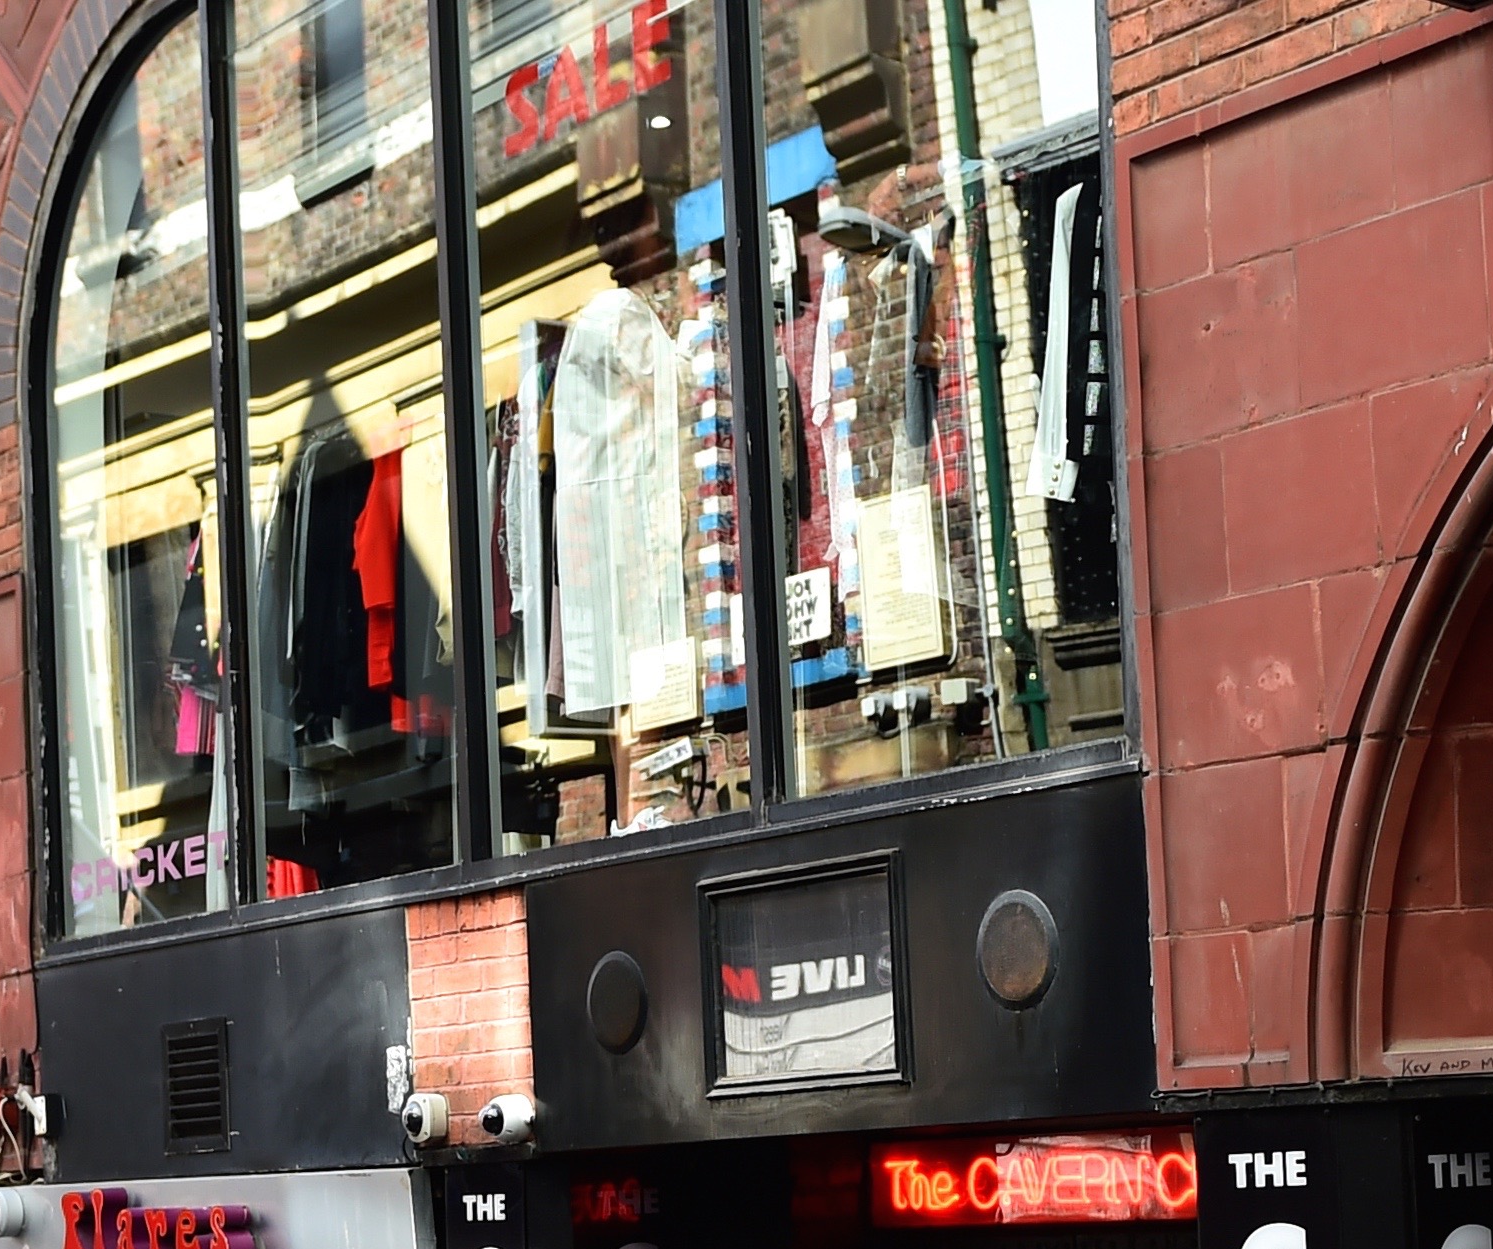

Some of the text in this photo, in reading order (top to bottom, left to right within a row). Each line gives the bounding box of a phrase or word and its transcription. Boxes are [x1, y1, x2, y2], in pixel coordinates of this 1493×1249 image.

[502, 0, 672, 158] SALE
[70, 831, 227, 904] CRICKET
[1440, 1060, 1471, 1071] AND
[883, 1152, 1149, 1212] The CAVERN
[1227, 1150, 1308, 1190] THE
[1427, 1152, 1493, 1190] THE
[463, 1192, 508, 1222] THE
[597, 1187, 660, 1218] THE
